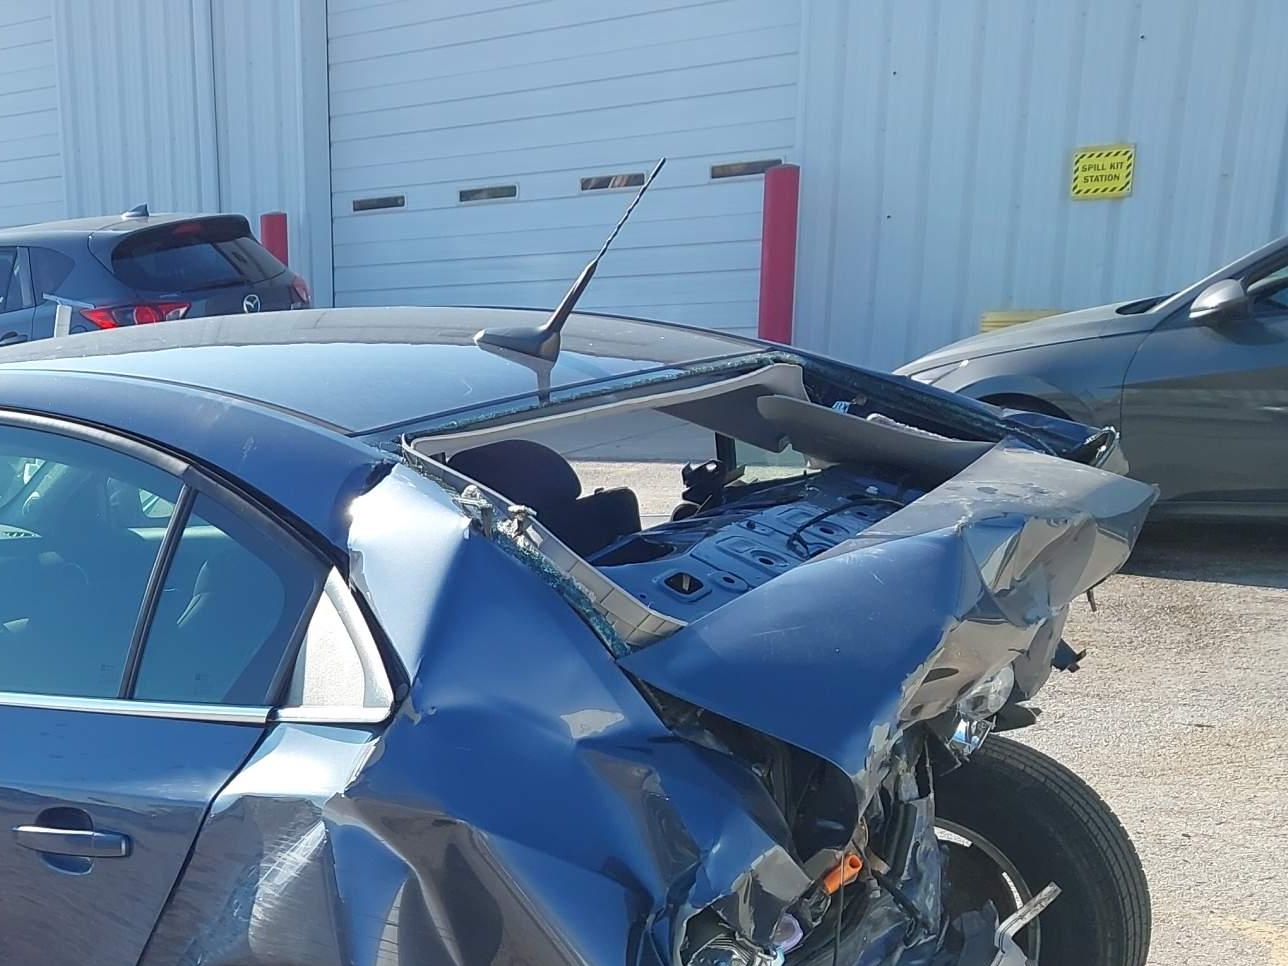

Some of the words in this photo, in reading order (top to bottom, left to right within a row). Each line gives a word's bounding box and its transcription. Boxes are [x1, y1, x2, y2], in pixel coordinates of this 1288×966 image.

[1081, 164, 1106, 172] SPILL
[1109, 162, 1124, 170] KIT
[1083, 174, 1120, 183] STATION
